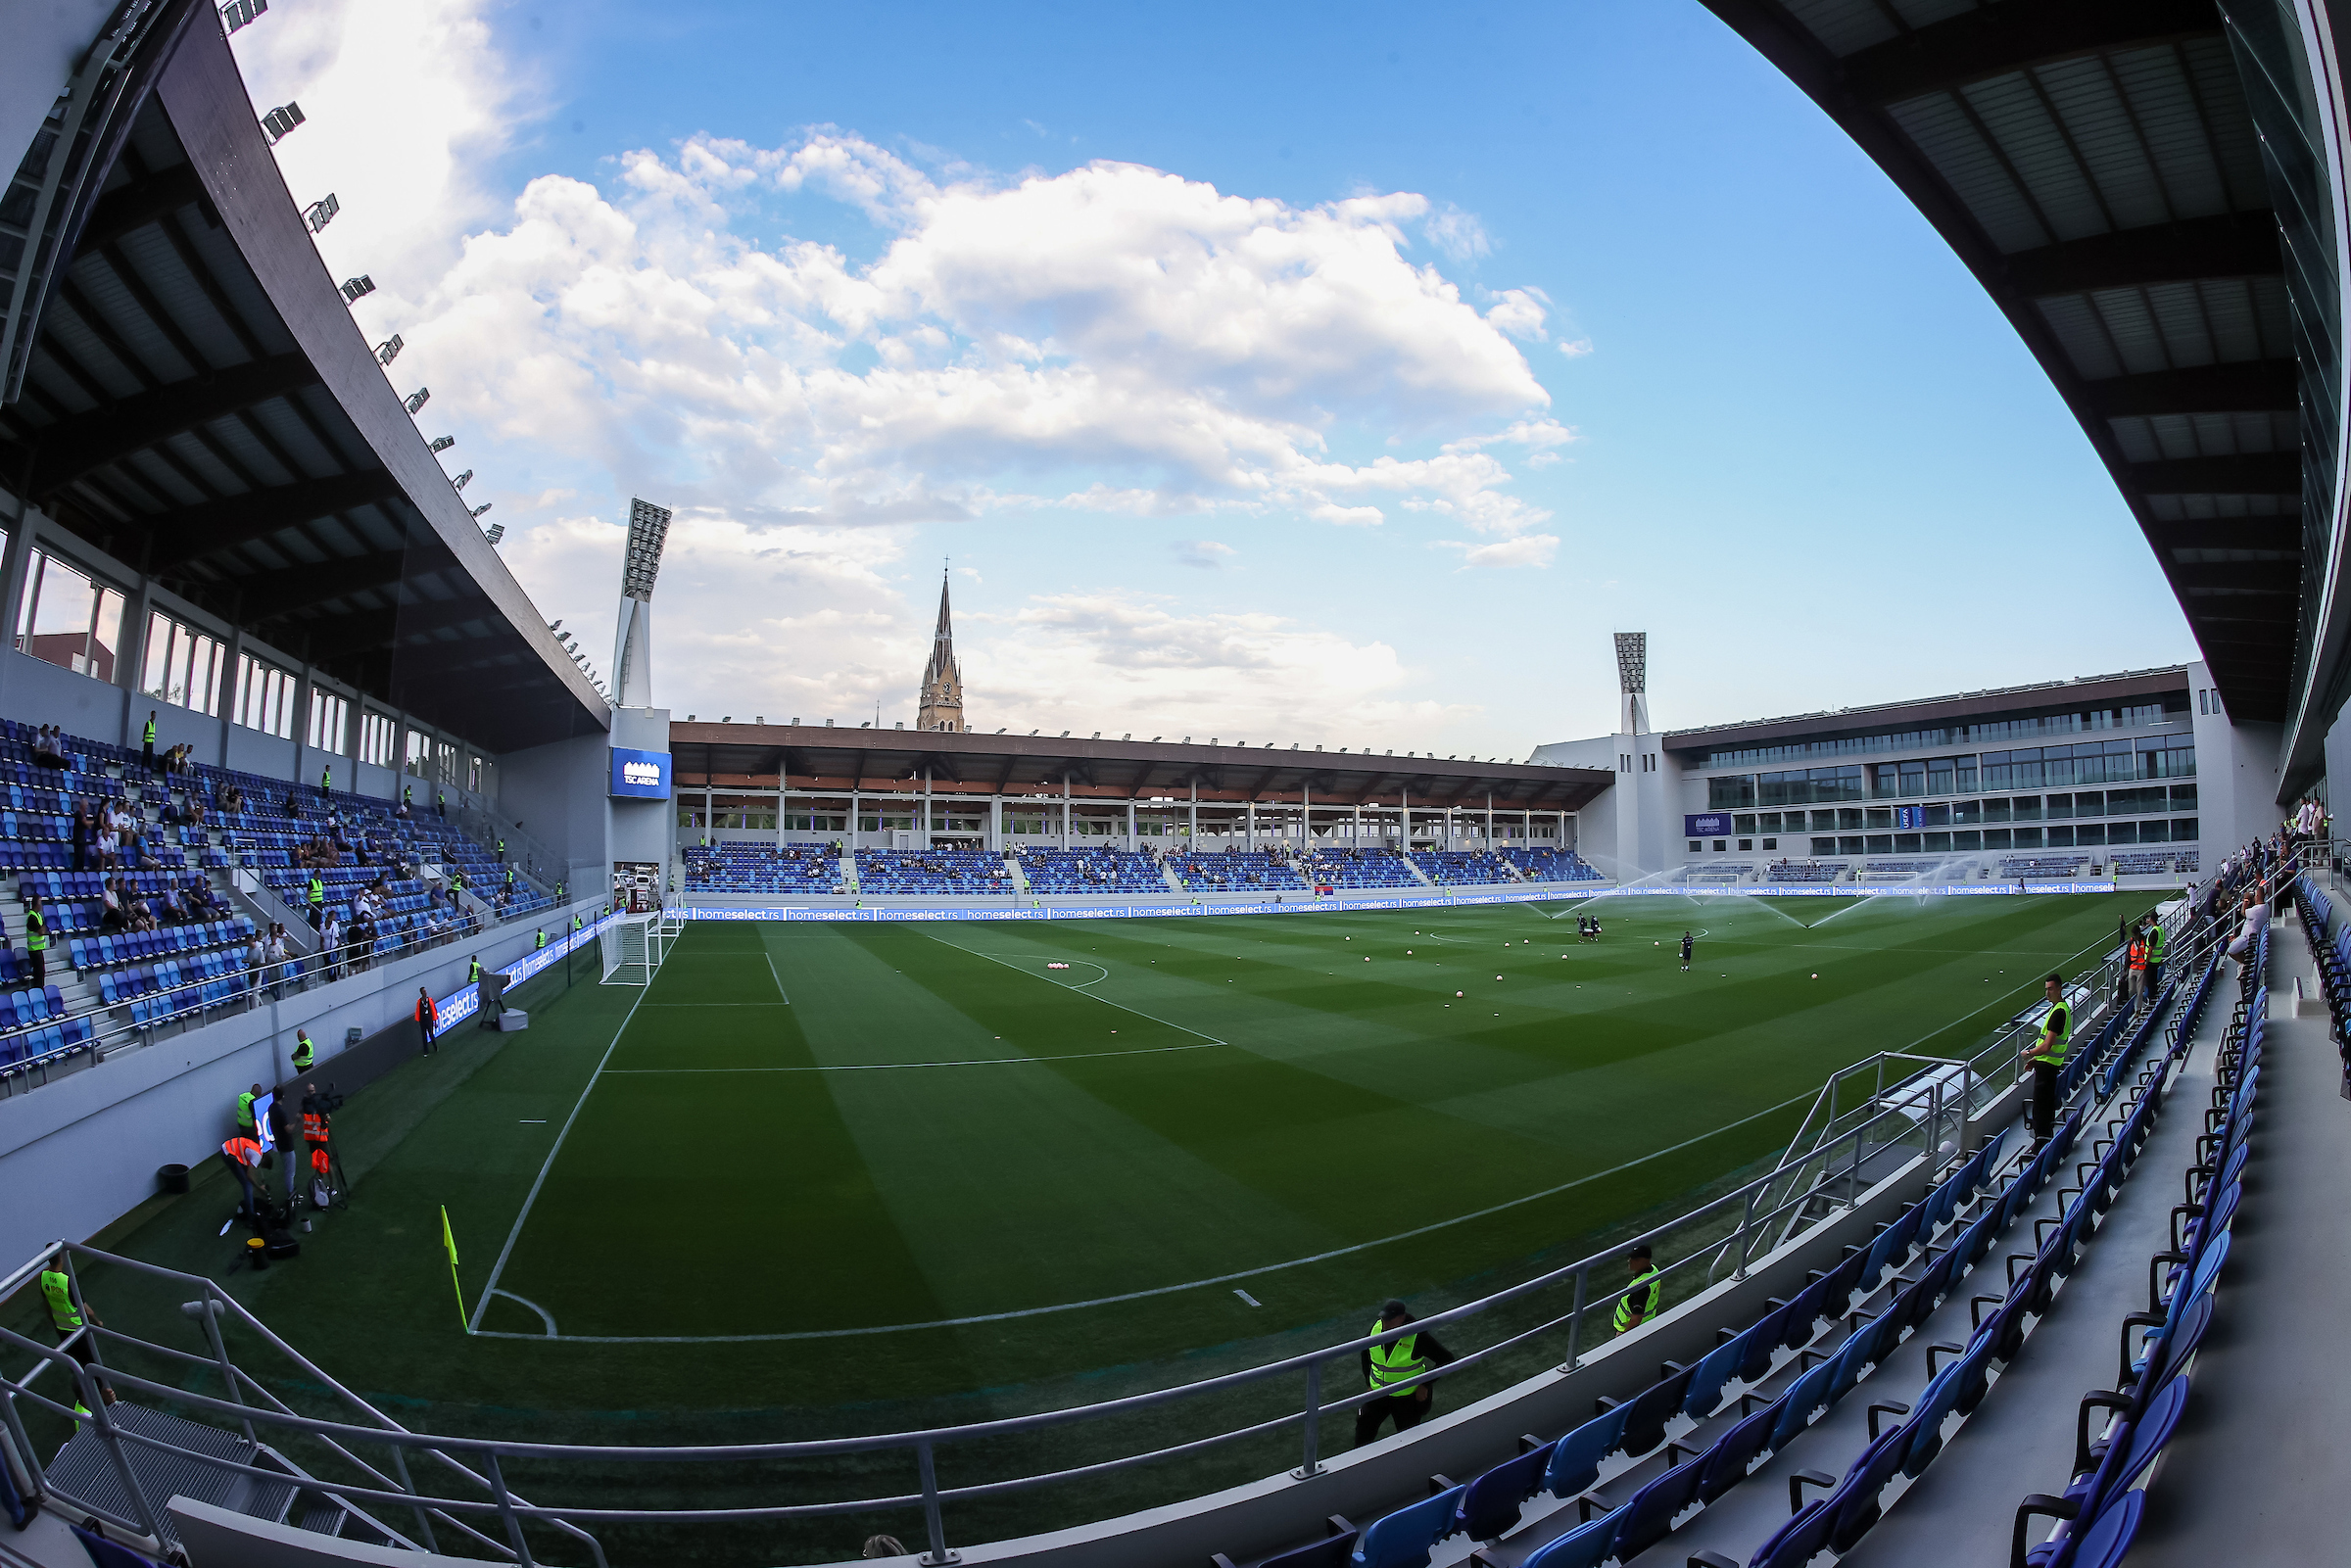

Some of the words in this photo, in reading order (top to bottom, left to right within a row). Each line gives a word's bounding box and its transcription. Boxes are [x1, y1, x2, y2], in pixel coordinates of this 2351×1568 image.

[624, 776, 637, 784] TSC
[637, 776, 659, 786] ARENA
[697, 909, 780, 920] homeselect.rs
[789, 909, 870, 920] homeselect.rs
[879, 909, 958, 920] homeselect.rs
[967, 909, 1044, 920] homeselect.rs
[1052, 908, 1125, 919] homeselect.rs
[1133, 905, 1201, 917] homeselect.rs
[1208, 904, 1271, 915] homeselect.rs
[1278, 902, 1337, 913] homeselect.rs
[1343, 900, 1398, 910] homeselect.rs
[1403, 897, 1452, 908] homeselect.rs
[1457, 895, 1502, 906] homeselect.rs
[1506, 892, 1547, 902] homeselect.rs
[1551, 889, 1588, 899] homeselect.rs
[1952, 885, 2006, 894] homeselect.rs
